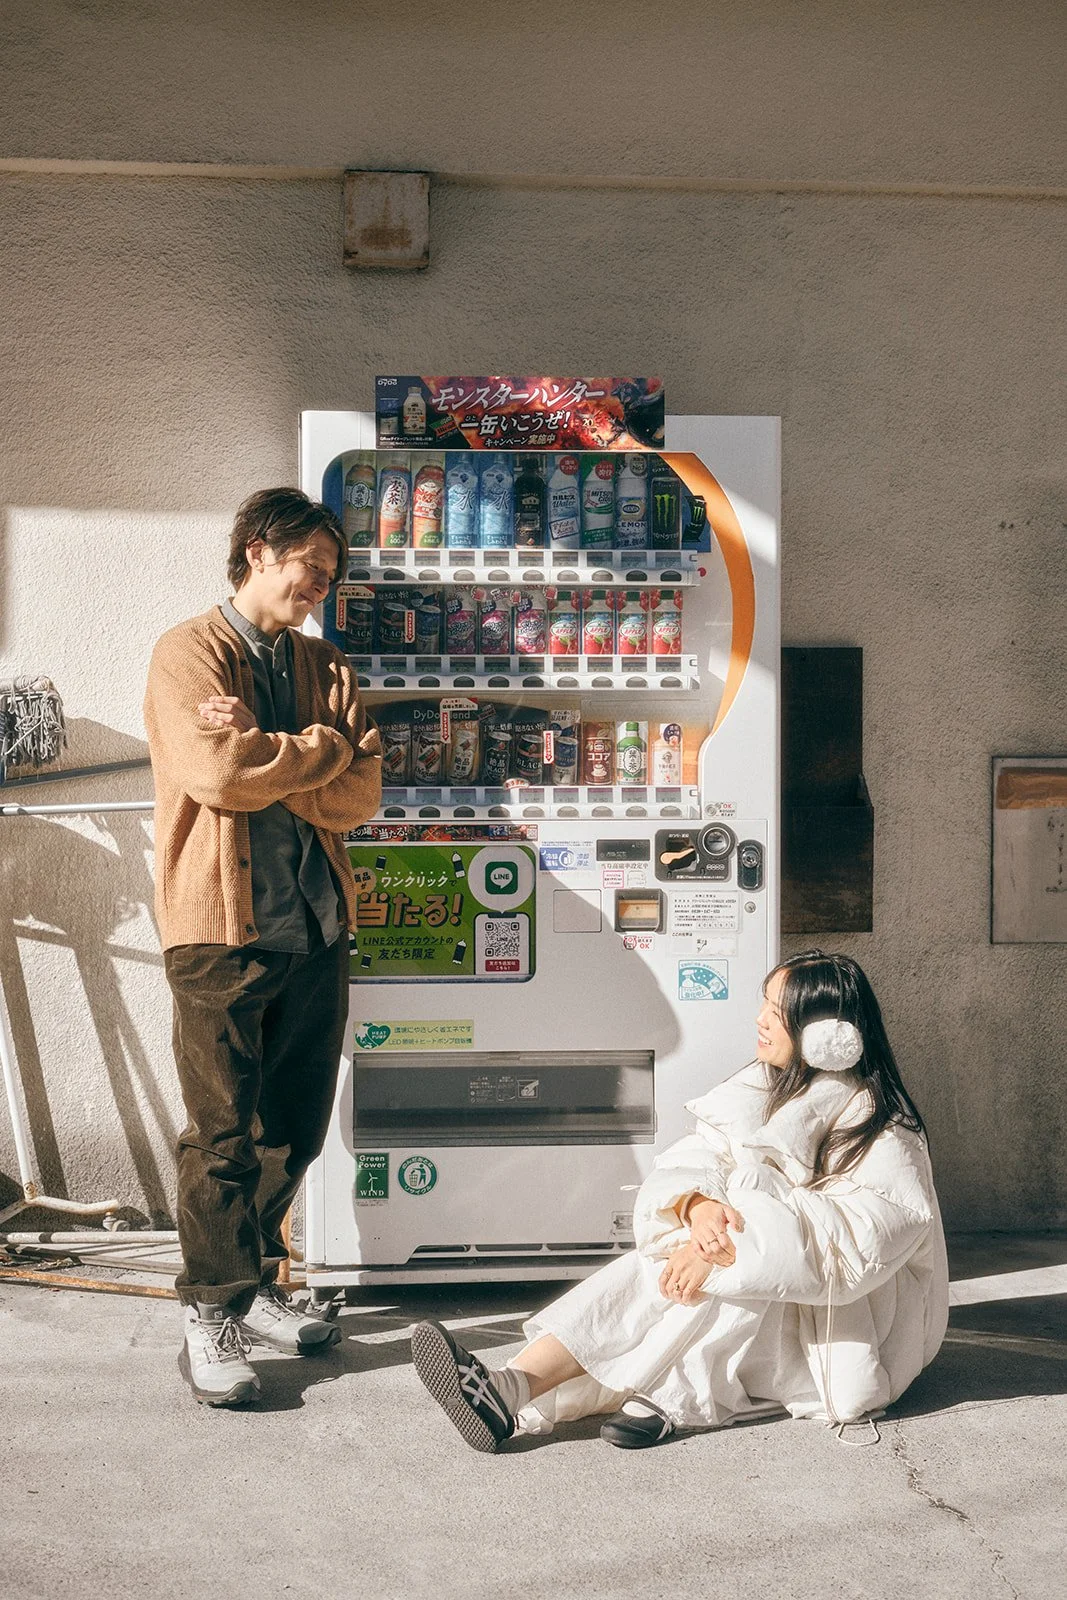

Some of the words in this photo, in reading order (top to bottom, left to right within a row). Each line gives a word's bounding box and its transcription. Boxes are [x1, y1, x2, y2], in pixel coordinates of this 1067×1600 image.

[432, 381, 605, 411] モンスターハンター
[485, 433, 556, 447] キャンペーン実施中
[387, 480, 401, 505] 麦茶
[454, 490, 475, 511] 水
[489, 490, 511, 511] 水
[587, 752, 611, 761] ココア
[350, 826, 408, 840] その場で当たる!
[380, 875, 449, 888] ワンクリック
[493, 873, 510, 881] LINE
[357, 891, 464, 928] 当たる!
[363, 935, 454, 946] LINE公式アカウントの
[378, 948, 436, 961] 友だち限定
[360, 1189, 385, 1197] WIND
